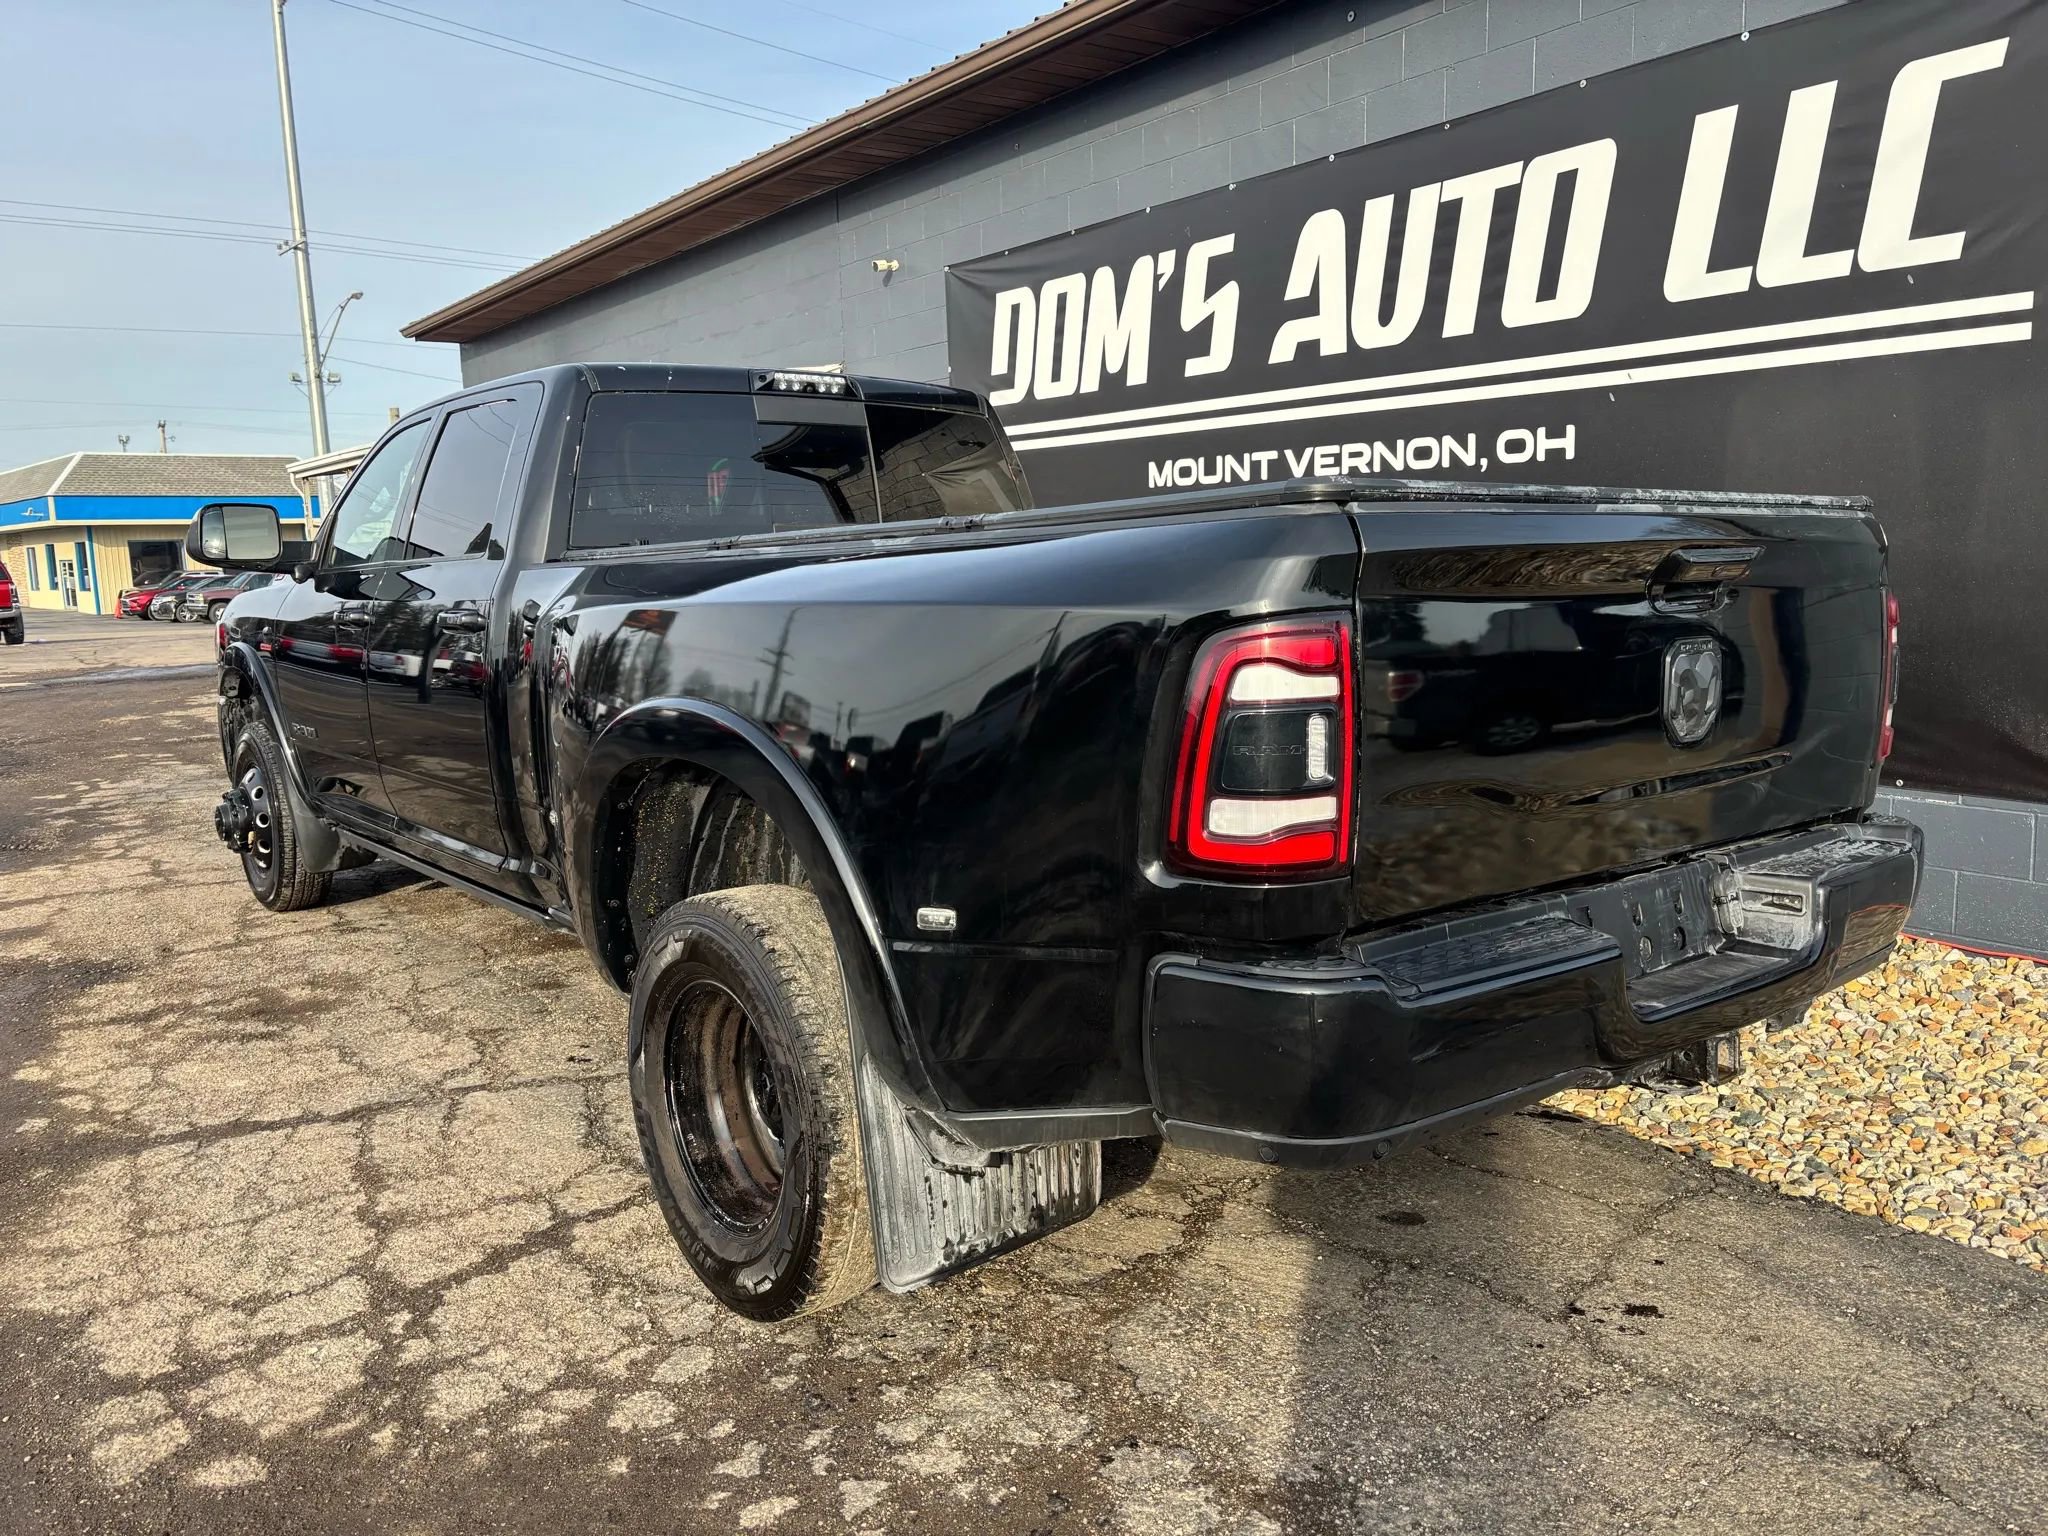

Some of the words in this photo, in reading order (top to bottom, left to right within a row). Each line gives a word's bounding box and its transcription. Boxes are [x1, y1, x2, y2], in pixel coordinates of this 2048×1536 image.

[989, 233, 1239, 407] DOM'S
[1268, 138, 1618, 364] AUTO
[1663, 37, 2010, 302] LLC
[1148, 450, 1279, 488] MOUNT
[1284, 433, 1489, 479] VERNON,
[1496, 424, 1576, 464] OH
[1232, 745, 1304, 755] RAM
